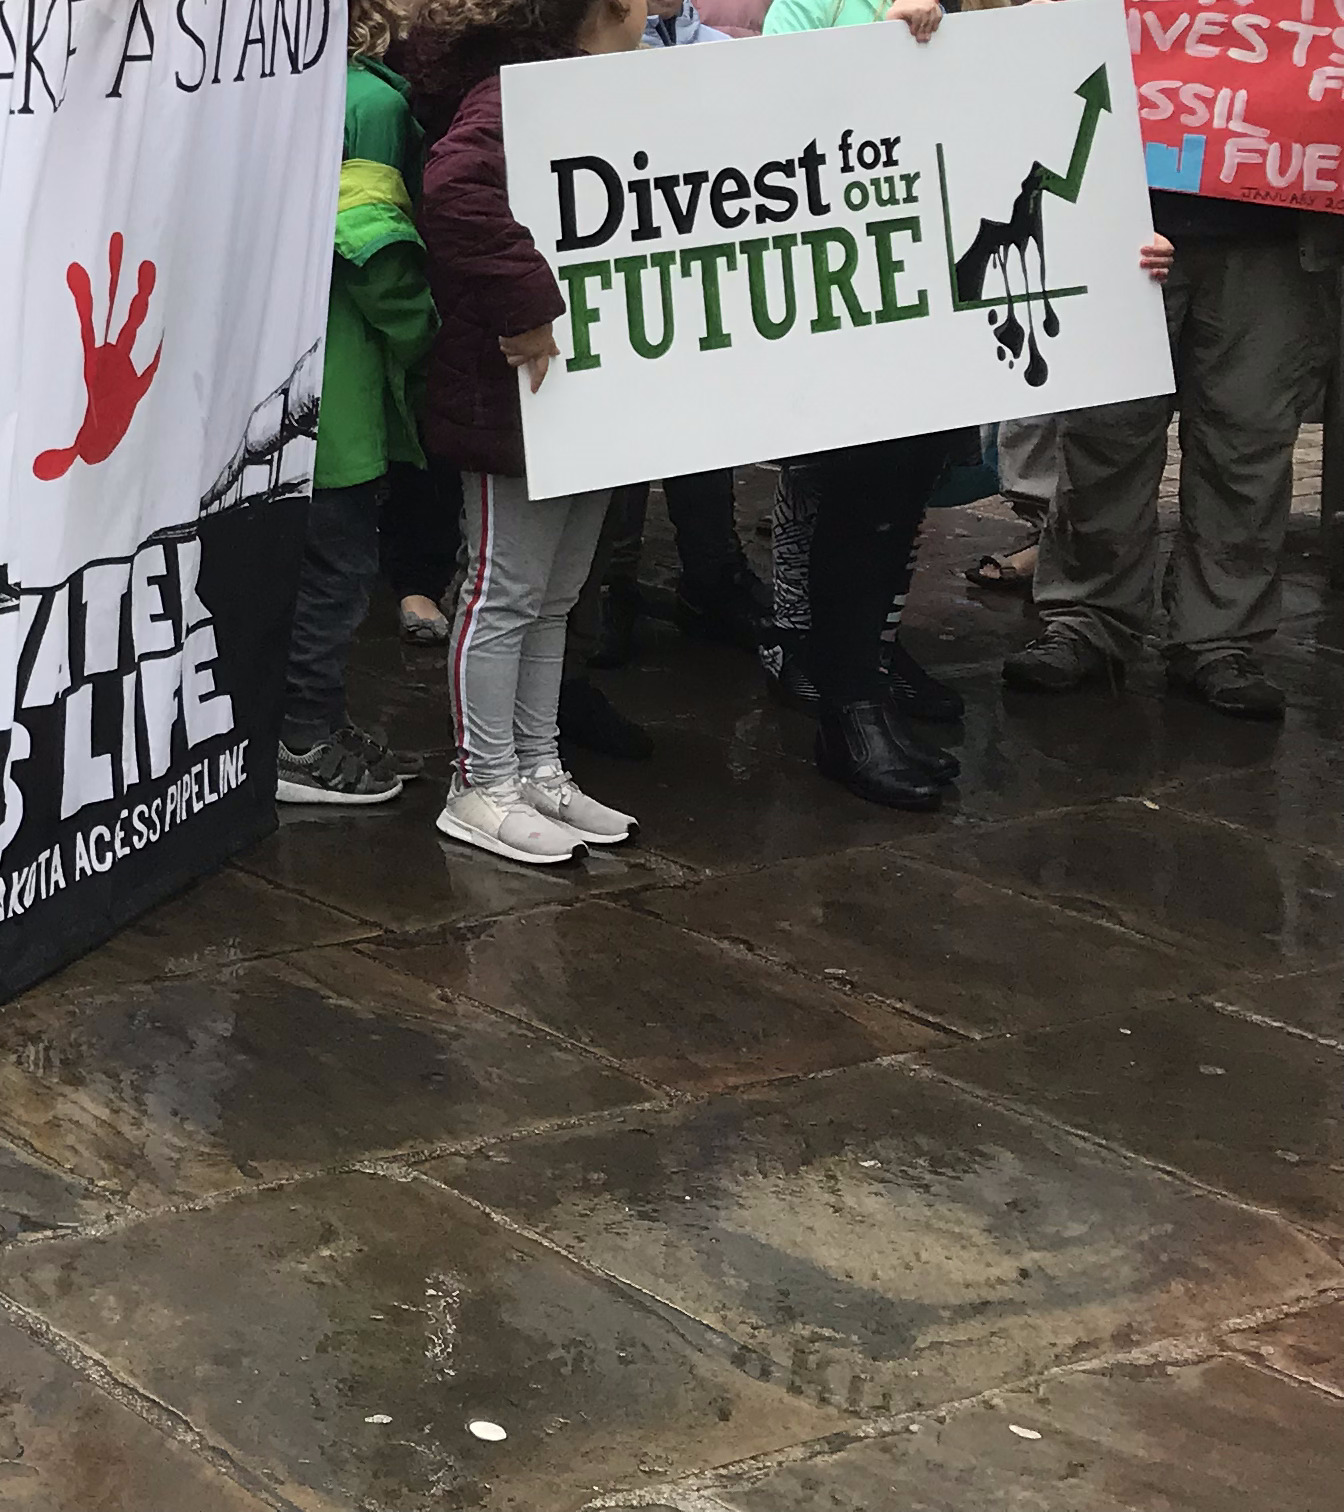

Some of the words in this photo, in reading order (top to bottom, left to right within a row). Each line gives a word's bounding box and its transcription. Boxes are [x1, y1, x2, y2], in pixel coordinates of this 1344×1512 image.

[550, 138, 831, 252] Divest
[838, 129, 901, 174] for
[843, 171, 921, 212] our
[1220, 136, 1344, 192] FUE
[558, 215, 930, 373] FUTURE
[60, 624, 235, 820] LIFE
[164, 738, 249, 833] PIPELINE
